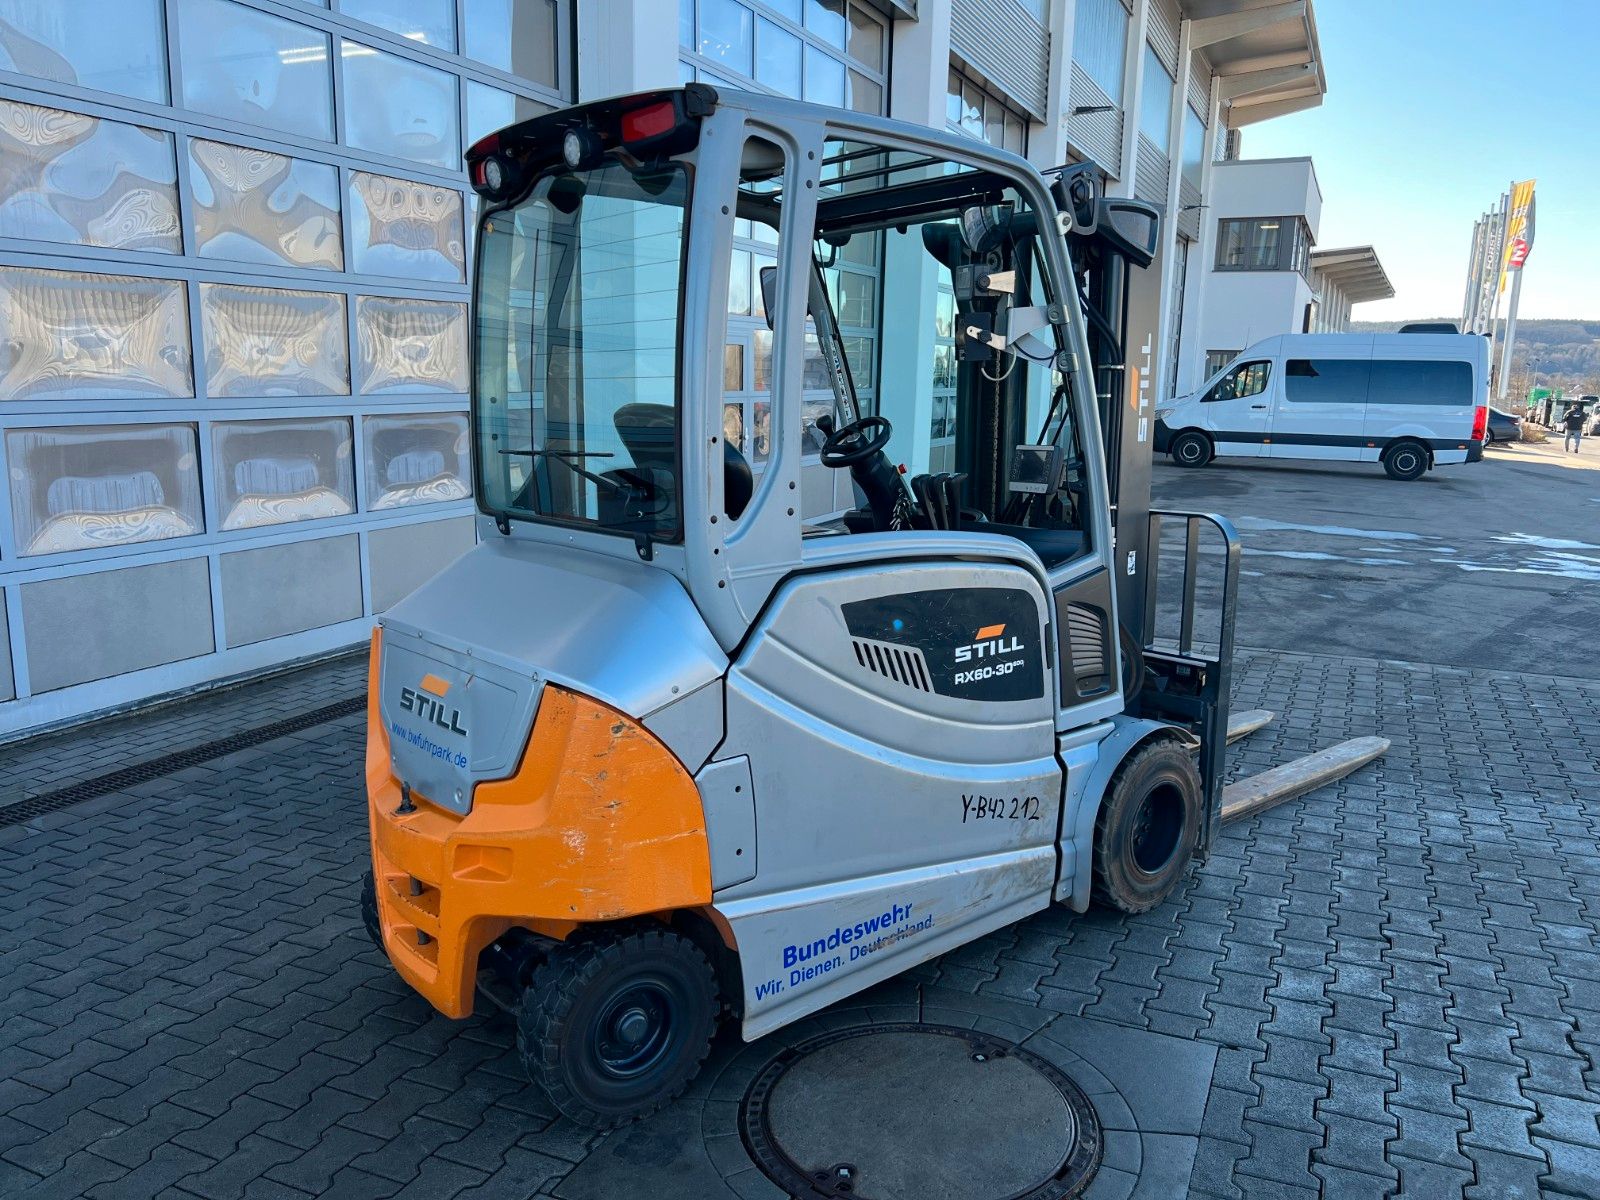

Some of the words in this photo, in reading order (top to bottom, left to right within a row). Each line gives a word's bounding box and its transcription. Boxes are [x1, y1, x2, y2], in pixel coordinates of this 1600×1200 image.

[1137, 332, 1152, 442] STILL
[955, 636, 1025, 663] STILL
[400, 687, 469, 737] STILL
[390, 721, 468, 769] www.bwfuhrpark.de
[783, 903, 913, 969] Bundeswehr
[755, 979, 786, 1001] Wir.
[790, 955, 846, 988] Dienen.
